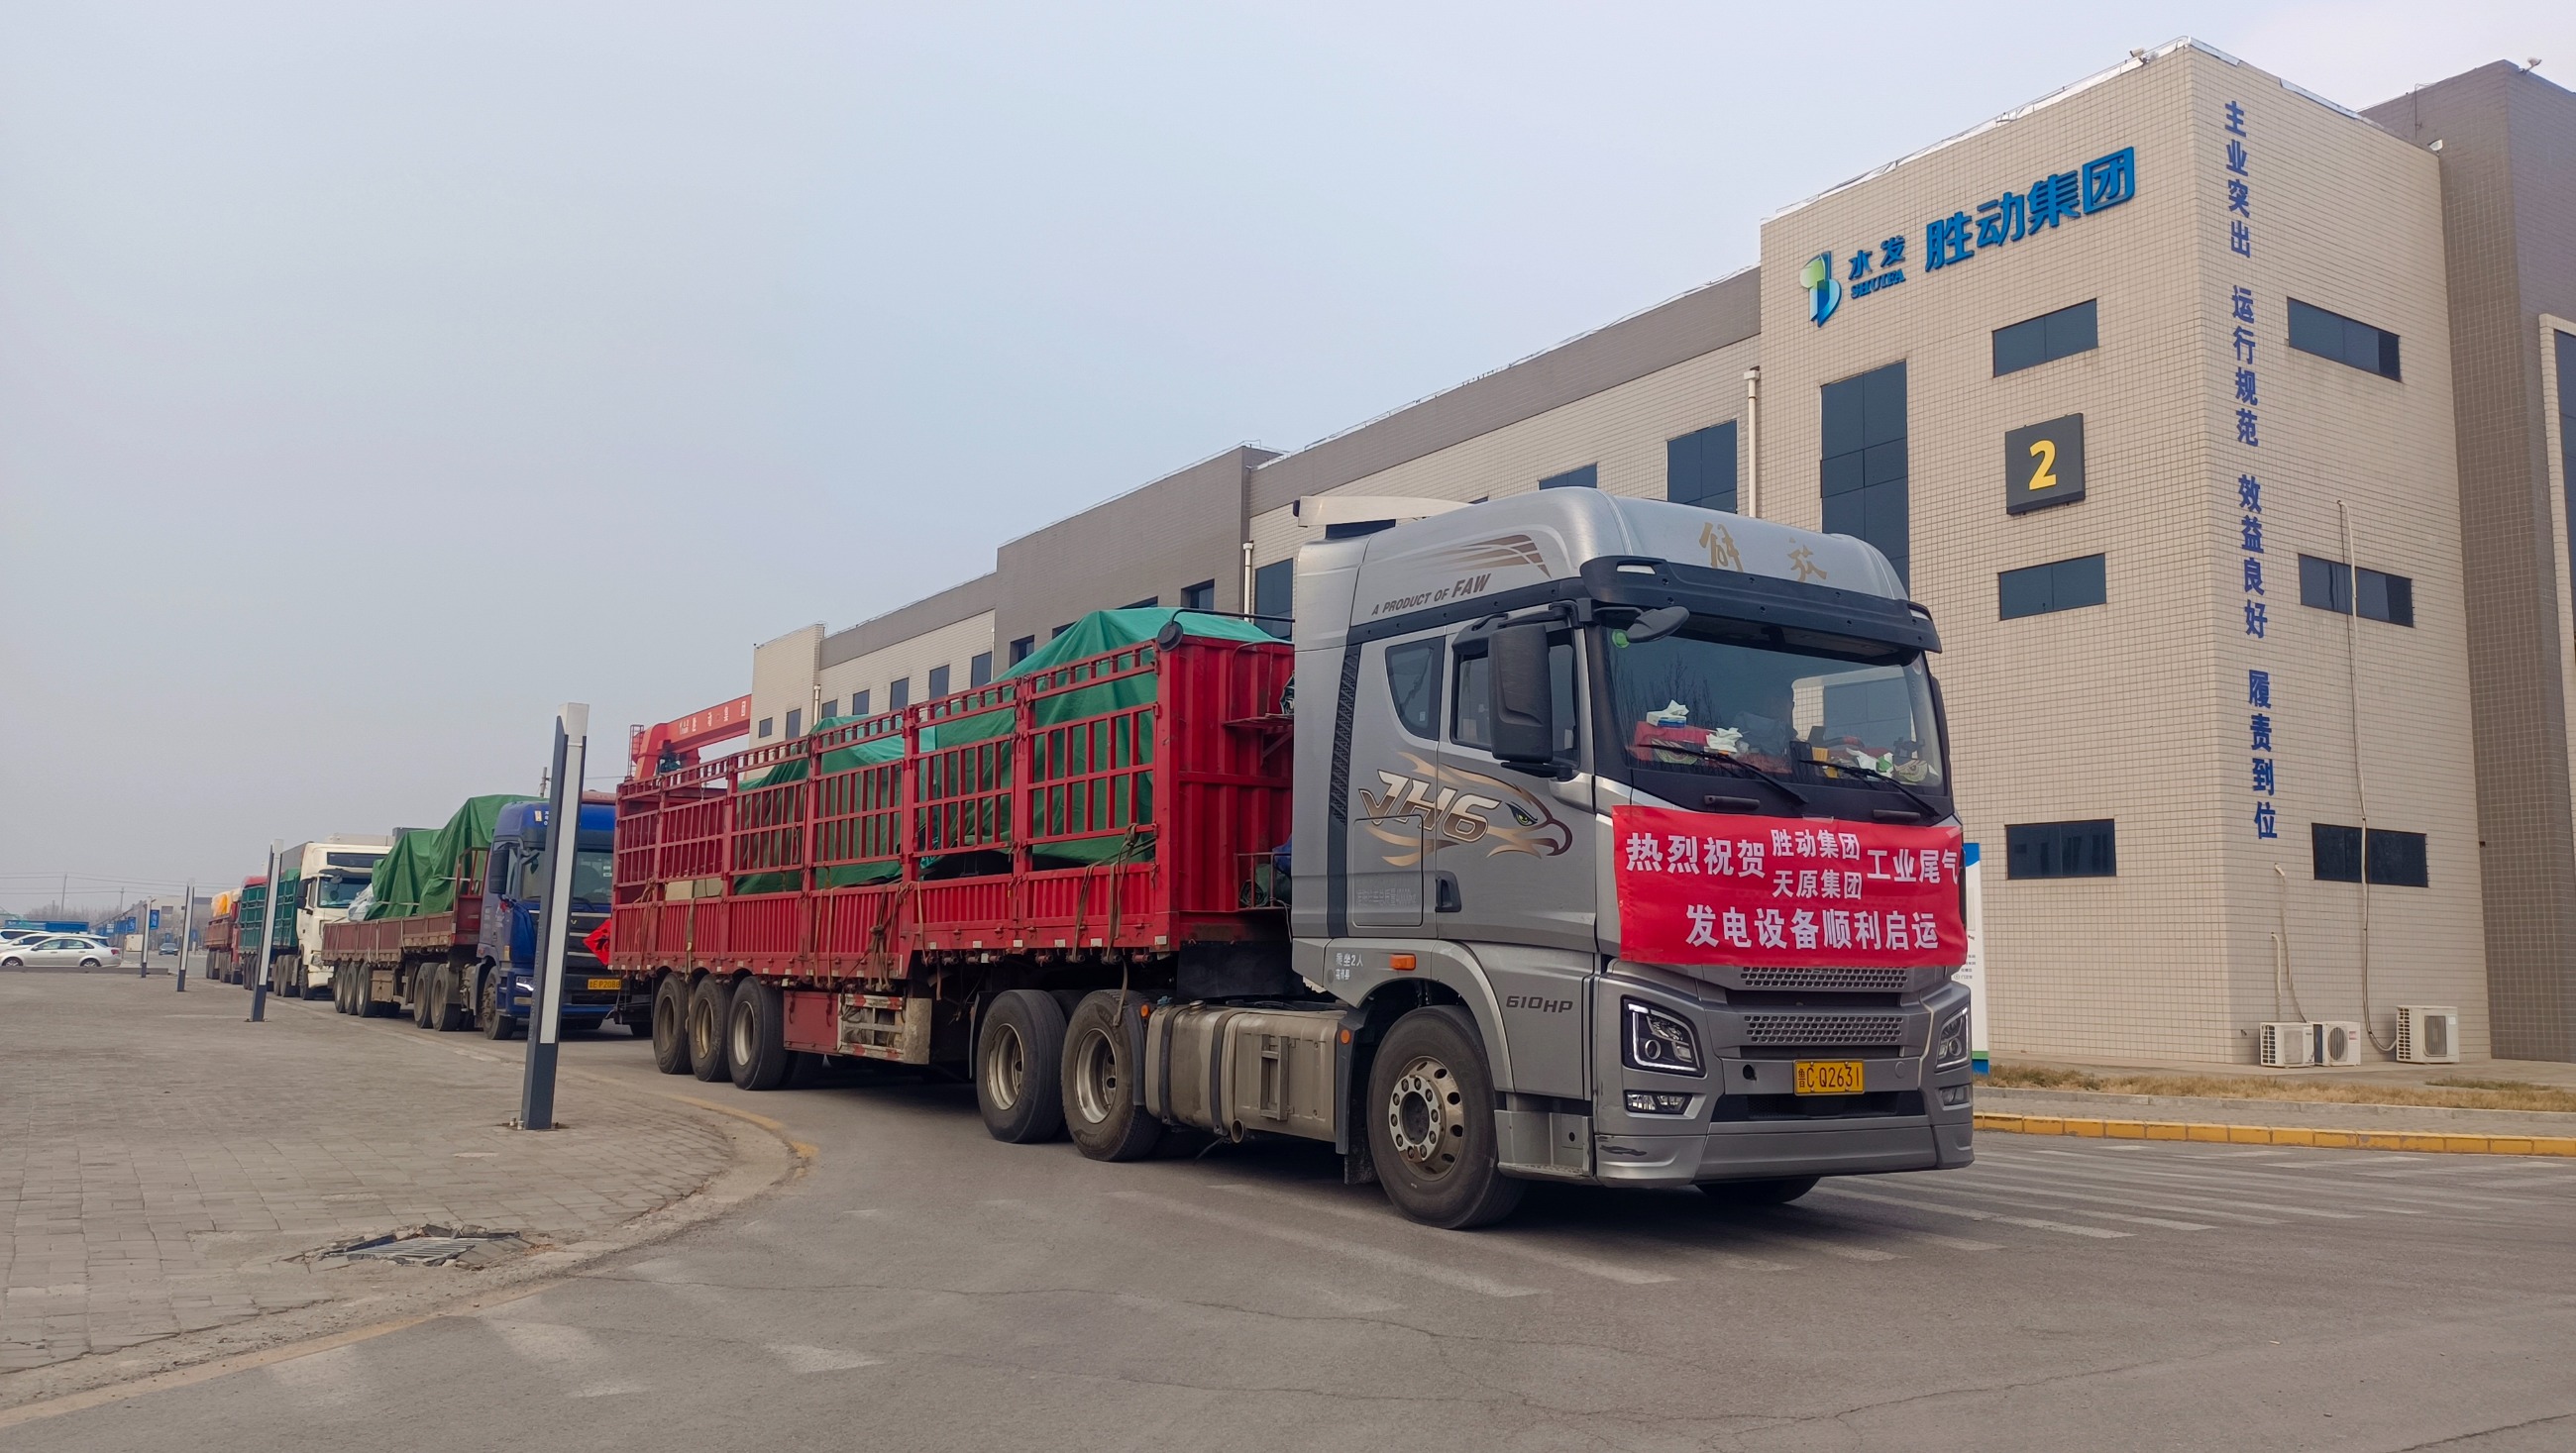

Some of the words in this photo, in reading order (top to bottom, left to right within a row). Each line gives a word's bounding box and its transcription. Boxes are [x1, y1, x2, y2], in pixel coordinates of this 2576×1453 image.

[2224, 100, 2251, 259] 主业突出
[1925, 146, 2135, 272] 胜动集团
[1848, 235, 1906, 280] 水发
[1851, 268, 1906, 299] SHUIFA
[2231, 284, 2259, 447] 运行规范
[2028, 439, 2057, 491] 2
[2238, 473, 2268, 639] 效益良好
[1371, 603, 1379, 616] A
[1382, 592, 1432, 614] PRODUCT
[1434, 587, 1449, 601] OF
[1451, 572, 1491, 598] FAW
[2248, 669, 2278, 840] 履责到位
[1357, 769, 1502, 843] JH6
[1625, 832, 1767, 879] 热烈祝贺
[1770, 829, 1861, 860] 胜动集团
[1867, 848, 1959, 884] 工业尾气
[1771, 869, 1863, 899] 天原集团
[1685, 904, 1940, 951] 发电设备顺利启运
[1505, 994, 1573, 1014] 610HP
